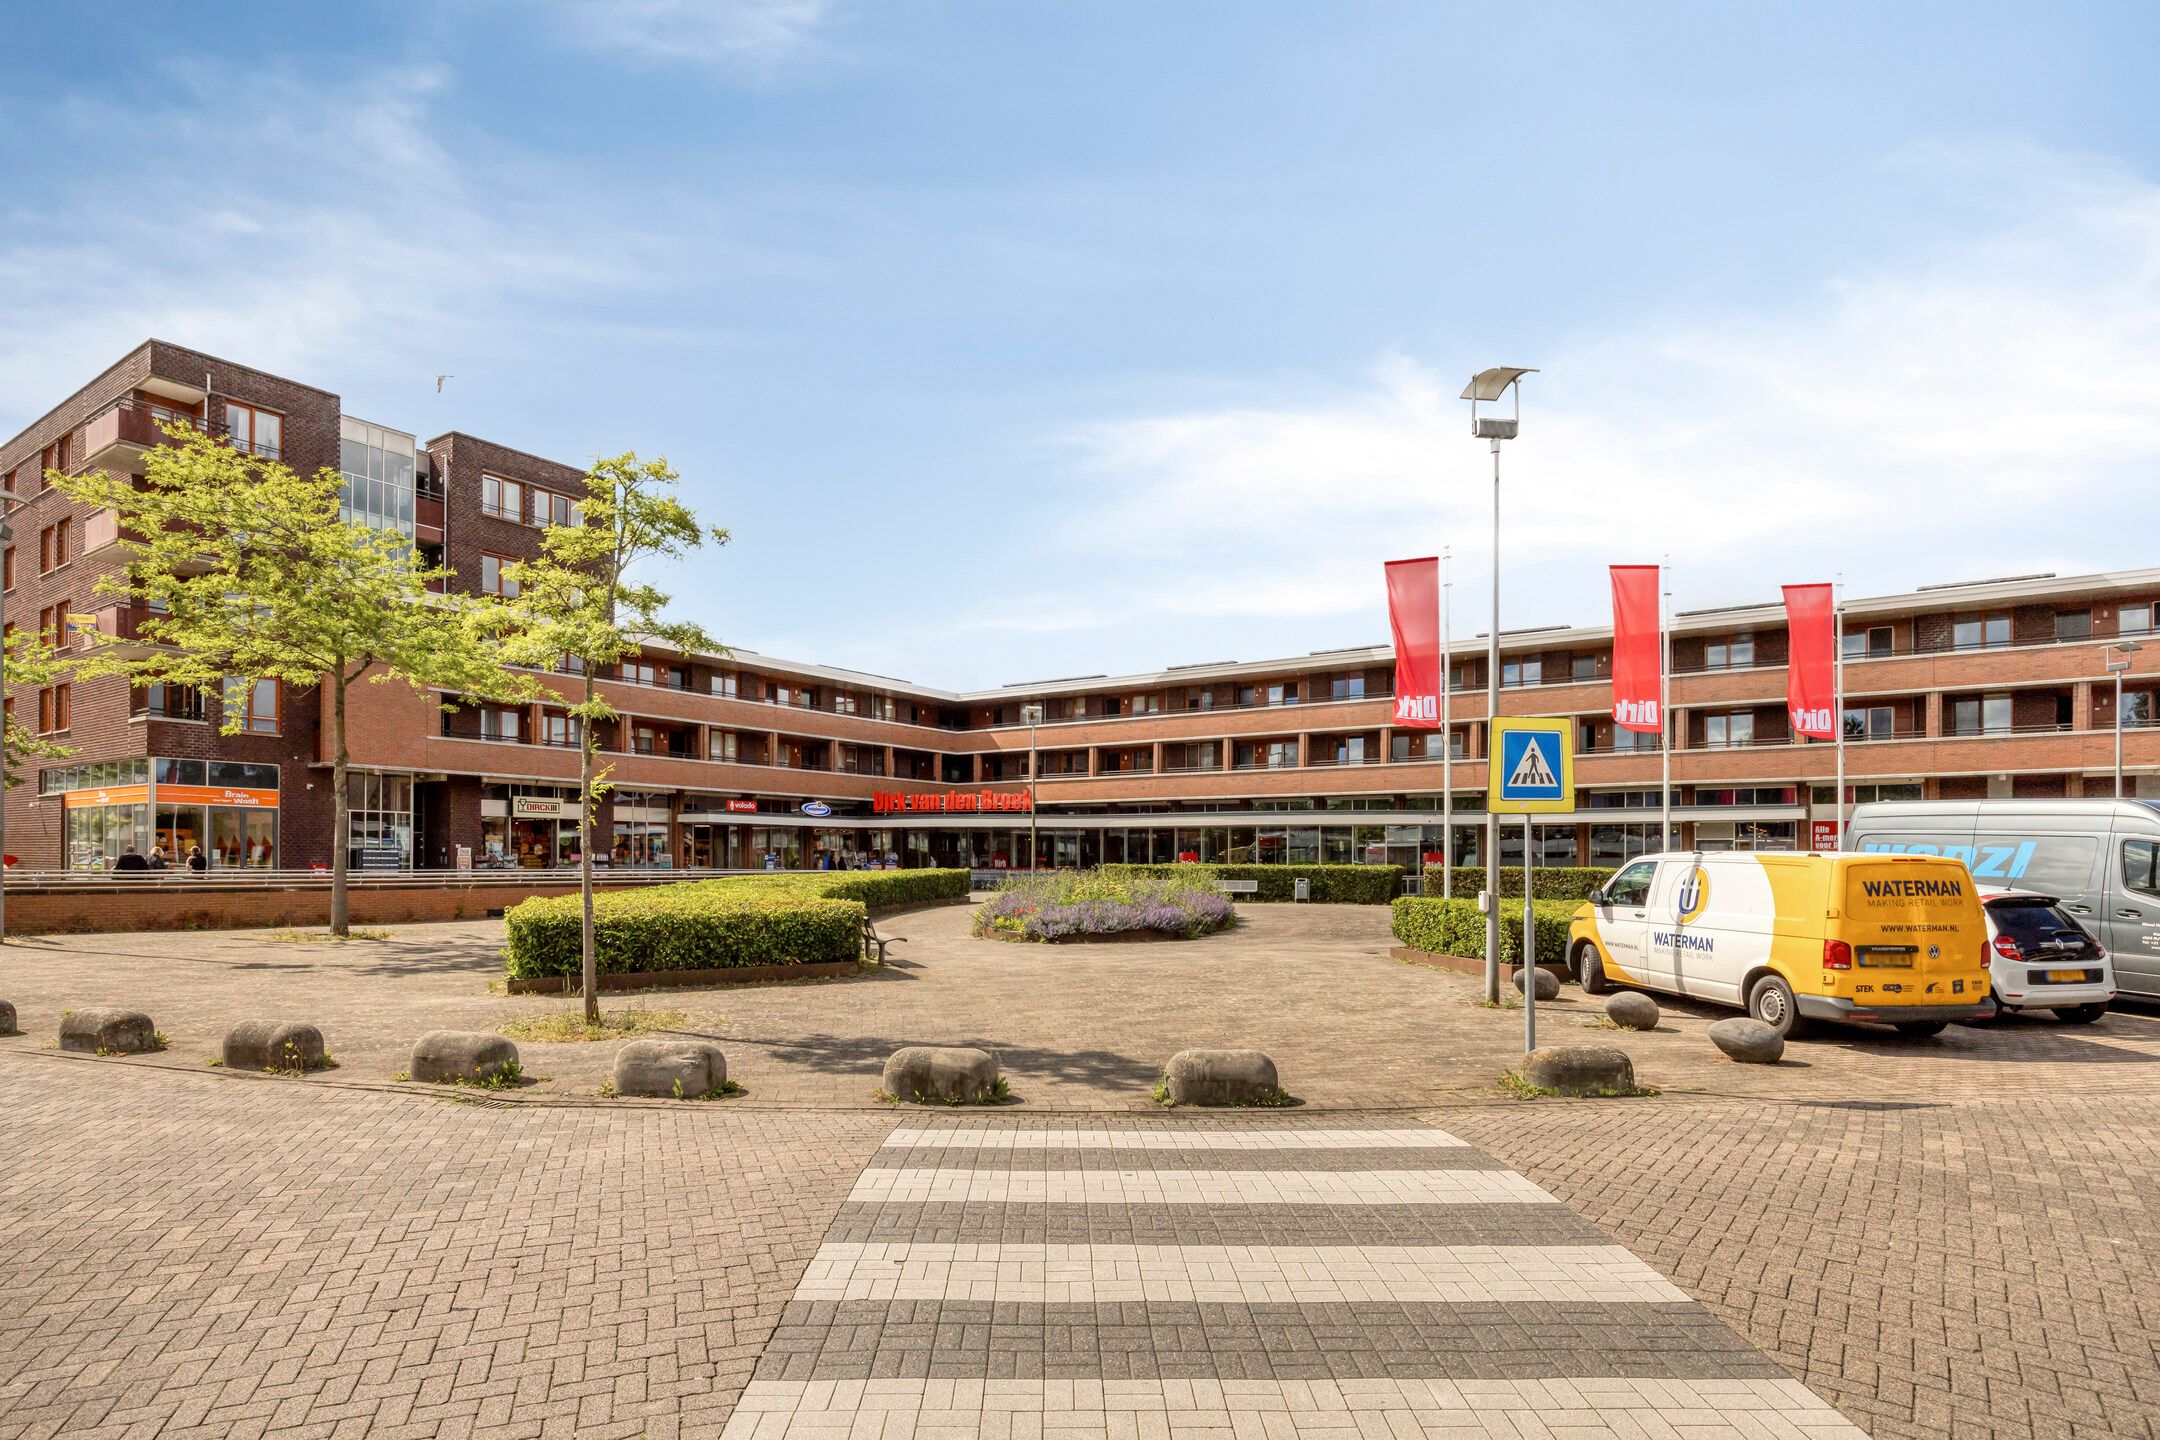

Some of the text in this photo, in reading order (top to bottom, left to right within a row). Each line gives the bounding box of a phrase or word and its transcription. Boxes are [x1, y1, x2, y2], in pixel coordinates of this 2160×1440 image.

[225, 790, 249, 798] Brain
[873, 790, 1032, 811] Dirk van den Broek
[1862, 880, 1962, 897] WATERMAN
[1867, 899, 1964, 907] MAKING RETAIL WORK
[1881, 924, 1960, 932] WWW.WATERMAN.NL
[1653, 931, 1714, 953] WATERMAN
[1653, 947, 1714, 962] MAKING RETAIL WORK
[1855, 984, 1875, 993] STEK
